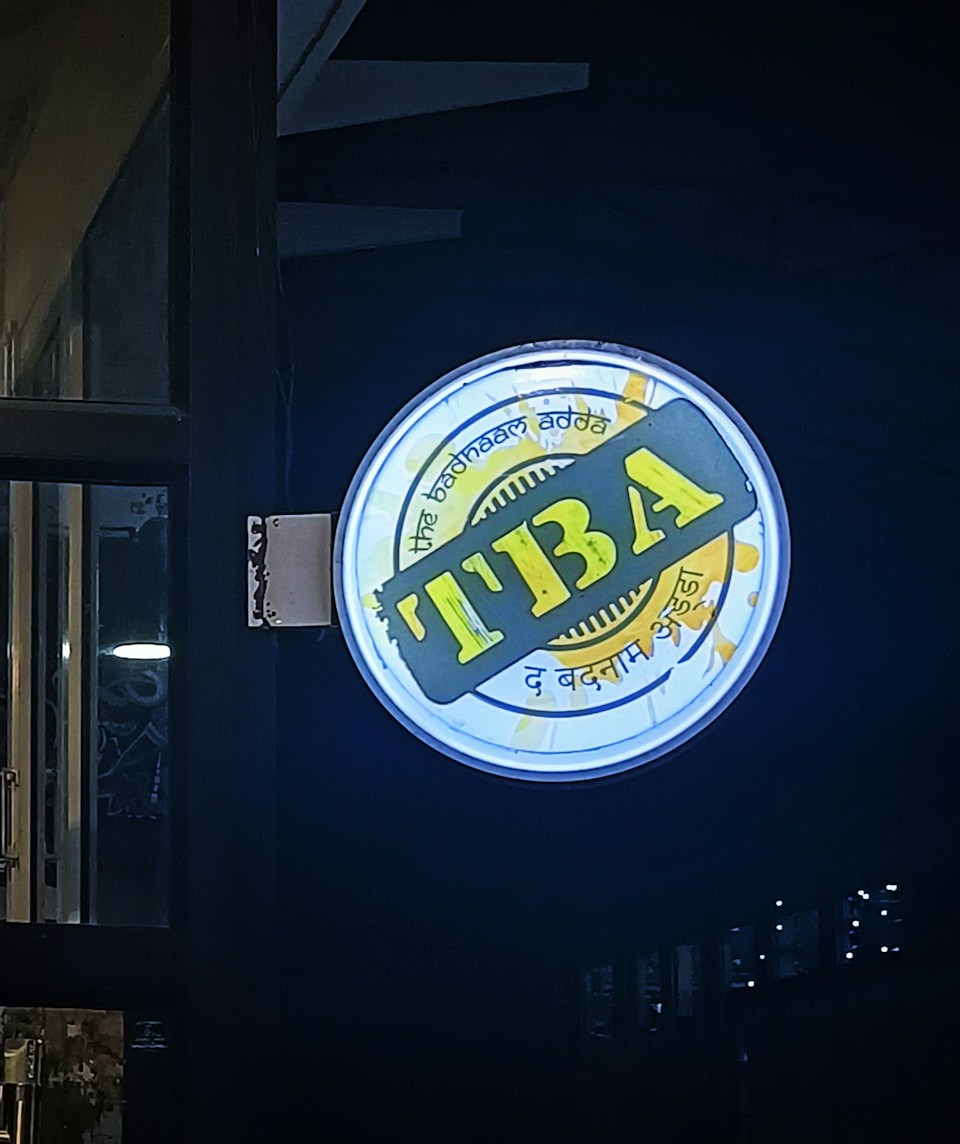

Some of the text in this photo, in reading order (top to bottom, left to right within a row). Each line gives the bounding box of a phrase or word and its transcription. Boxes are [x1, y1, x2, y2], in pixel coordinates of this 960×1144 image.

[408, 406, 611, 554] the badnaam adda
[396, 446, 724, 665] TBA
[554, 639, 651, 692] बदनाम
[650, 565, 707, 640] अड्डा
